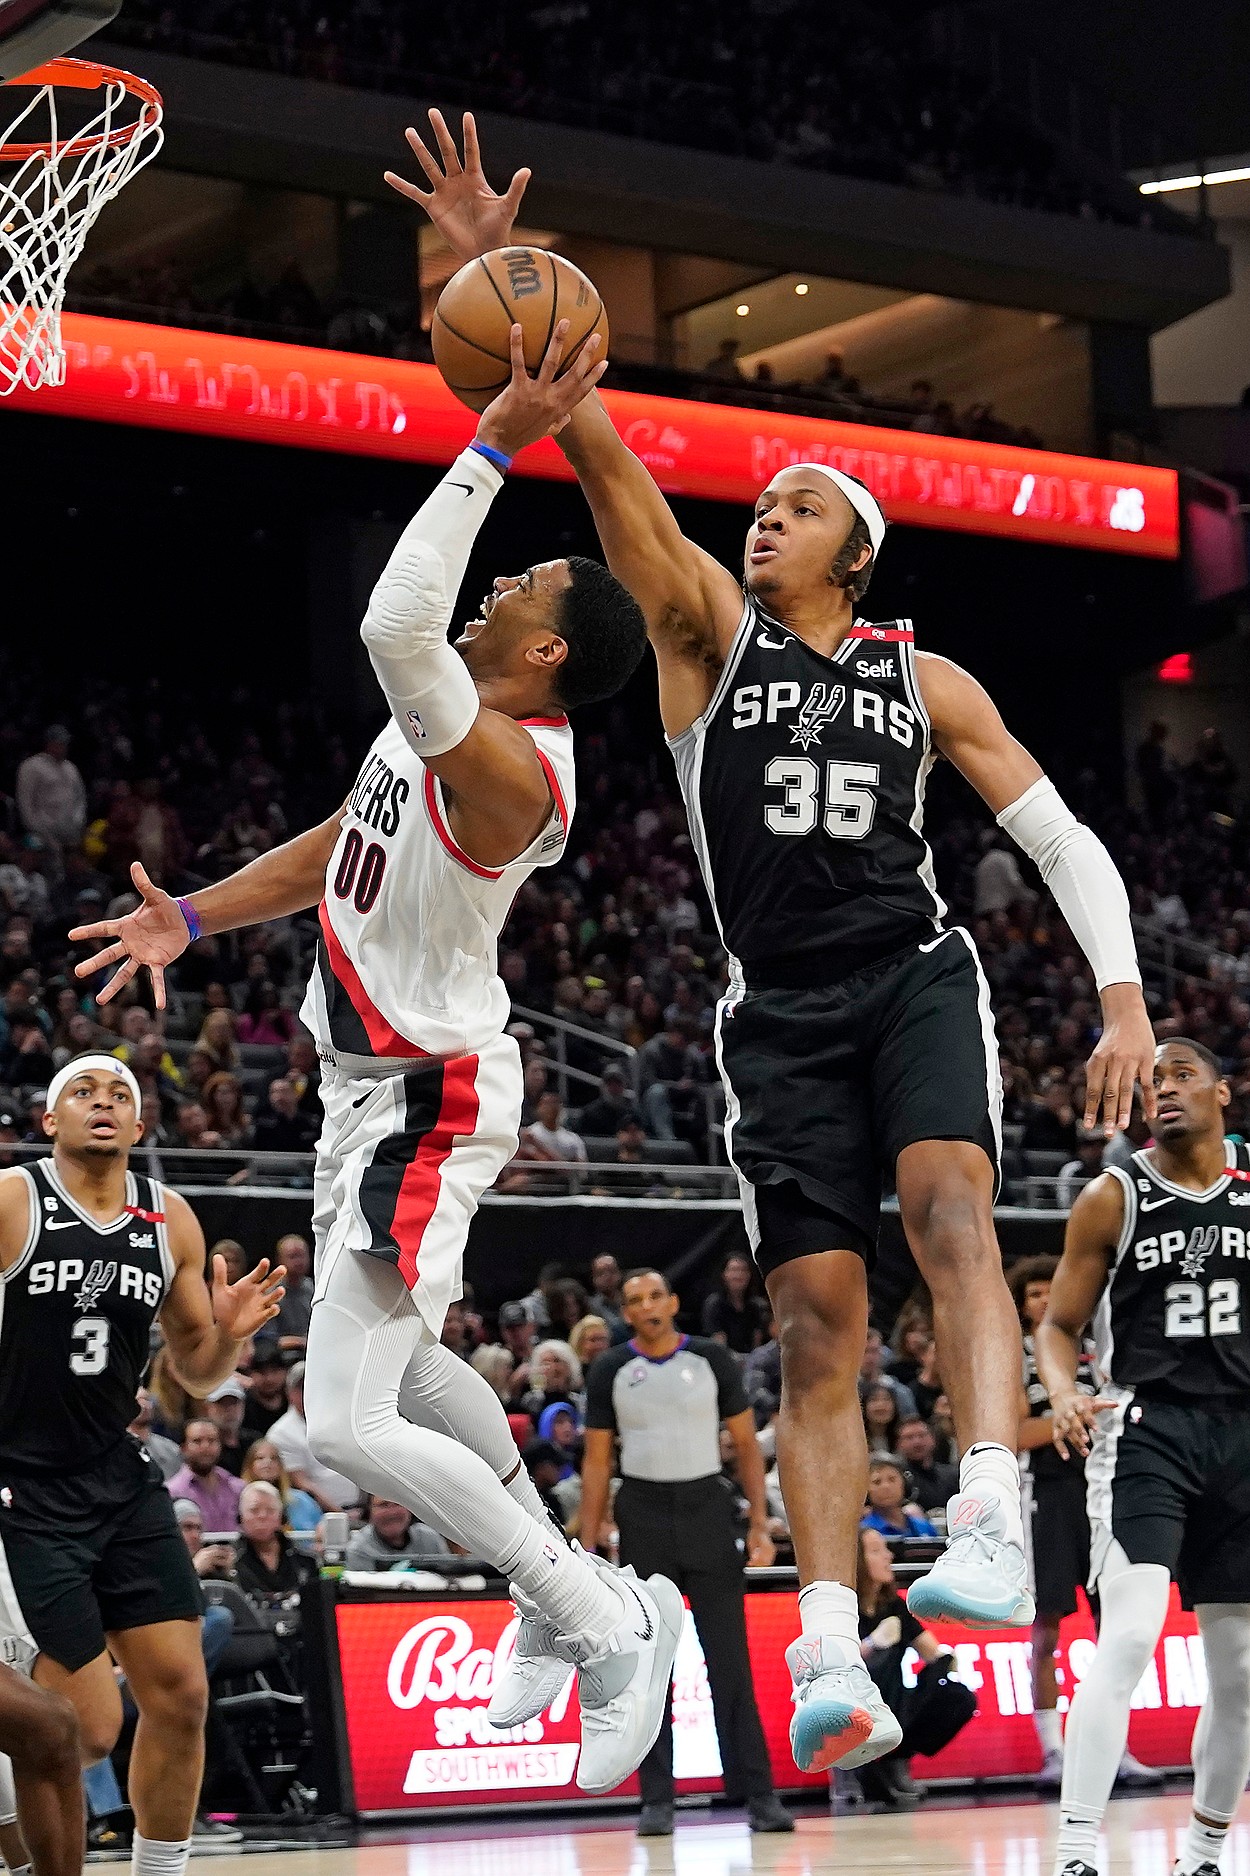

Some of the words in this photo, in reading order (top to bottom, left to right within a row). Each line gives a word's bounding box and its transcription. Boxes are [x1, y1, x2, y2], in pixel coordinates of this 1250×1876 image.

[855, 658, 898, 678] Self.
[732, 681, 915, 751] SPURS
[764, 756, 880, 839] 35
[333, 828, 387, 915] 00
[1134, 1225, 1250, 1278] SPUR
[28, 1259, 163, 1312] SPURS
[1164, 1278, 1242, 1338] 22
[69, 1316, 111, 1376] 3
[425, 1752, 559, 1785] SOUTHWEST
